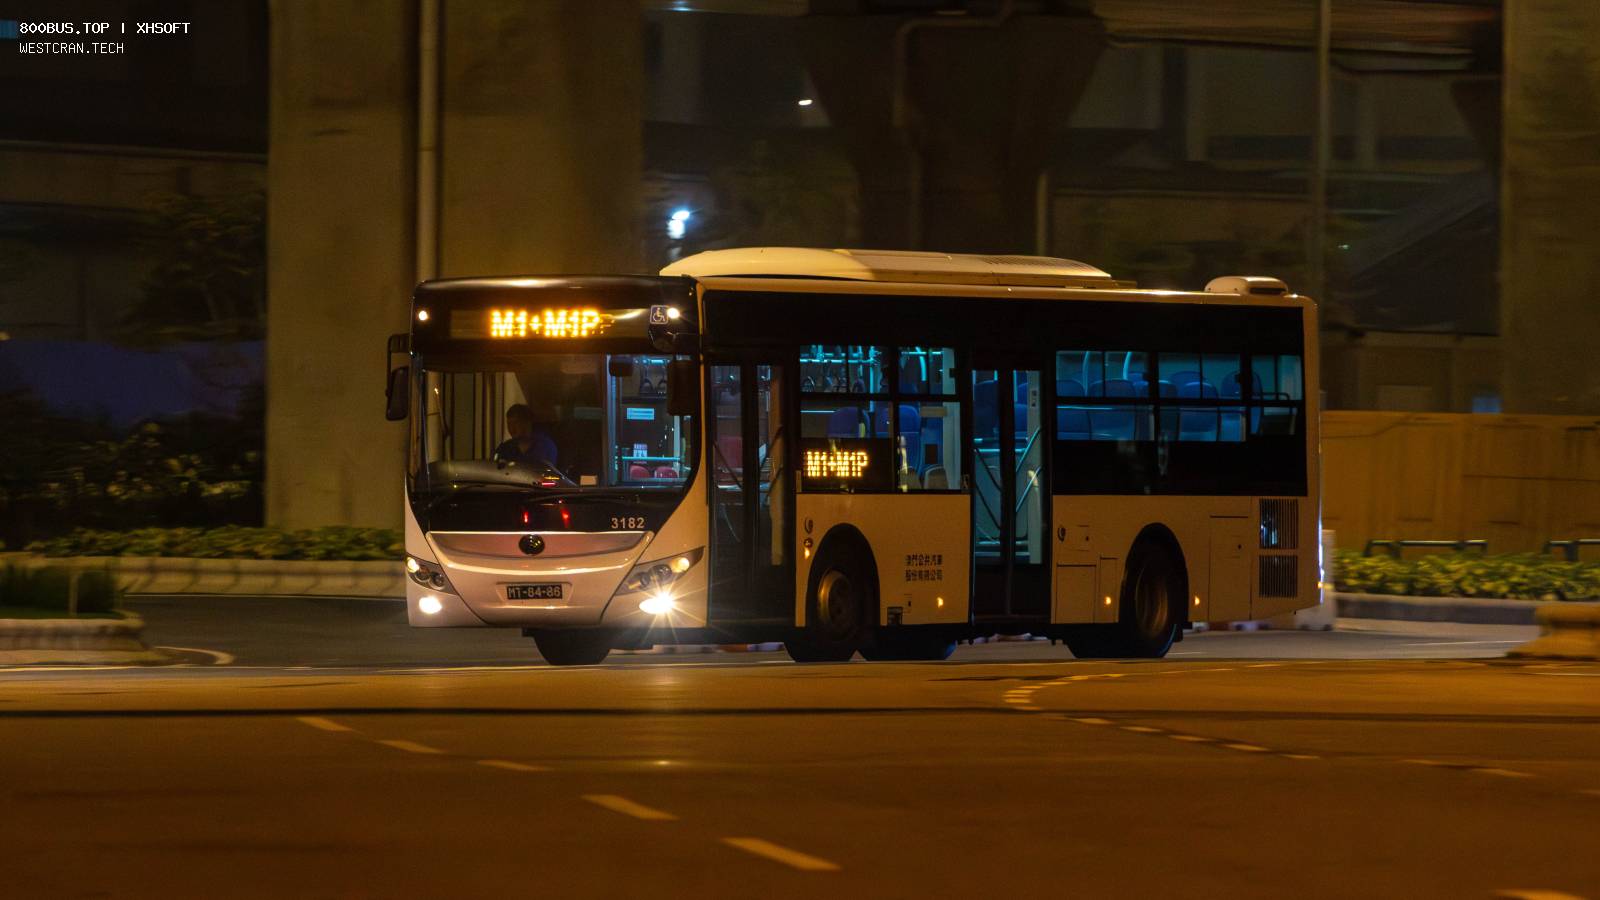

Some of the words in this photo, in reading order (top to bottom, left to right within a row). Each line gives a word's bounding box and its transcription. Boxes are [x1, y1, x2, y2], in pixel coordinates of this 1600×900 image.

[806, 451, 868, 477] M1+M1P
[611, 517, 645, 529] 3182
[508, 586, 561, 598] MT-84-86
